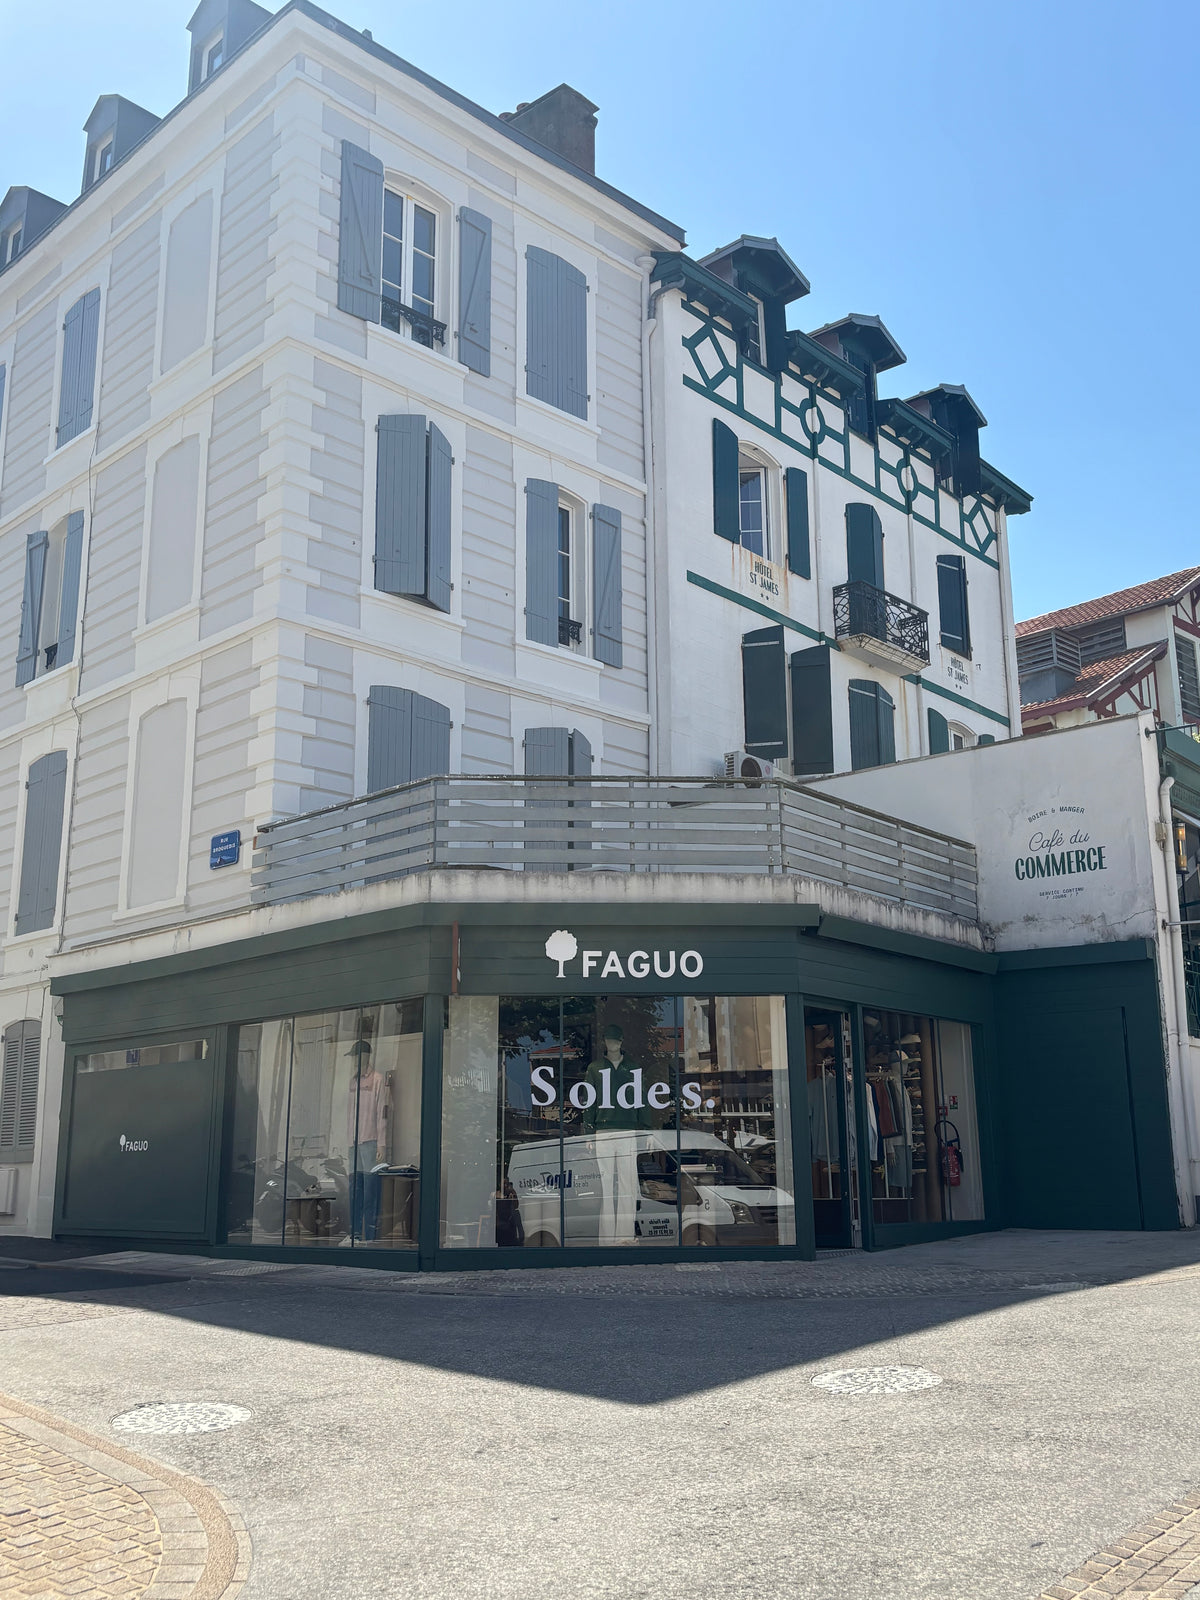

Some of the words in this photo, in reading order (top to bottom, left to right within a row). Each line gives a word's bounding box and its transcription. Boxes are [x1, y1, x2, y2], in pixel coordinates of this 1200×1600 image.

[754, 560, 774, 581] HÔTEL
[749, 571, 757, 585] ST
[759, 576, 779, 596] JAMES
[950, 656, 965, 673] HÔTEL
[947, 666, 953, 678] ST
[954, 669, 969, 686] JAMES
[1027, 809, 1048, 823] BOIRE
[1059, 806, 1085, 814] MANGER
[1028, 829, 1064, 853] Café
[1069, 829, 1091, 844] du
[1014, 846, 1108, 881] COMMERCE
[581, 950, 705, 979] FAGUO
[530, 1065, 717, 1110] Soldes.
[125, 1140, 148, 1152] FAGUO
